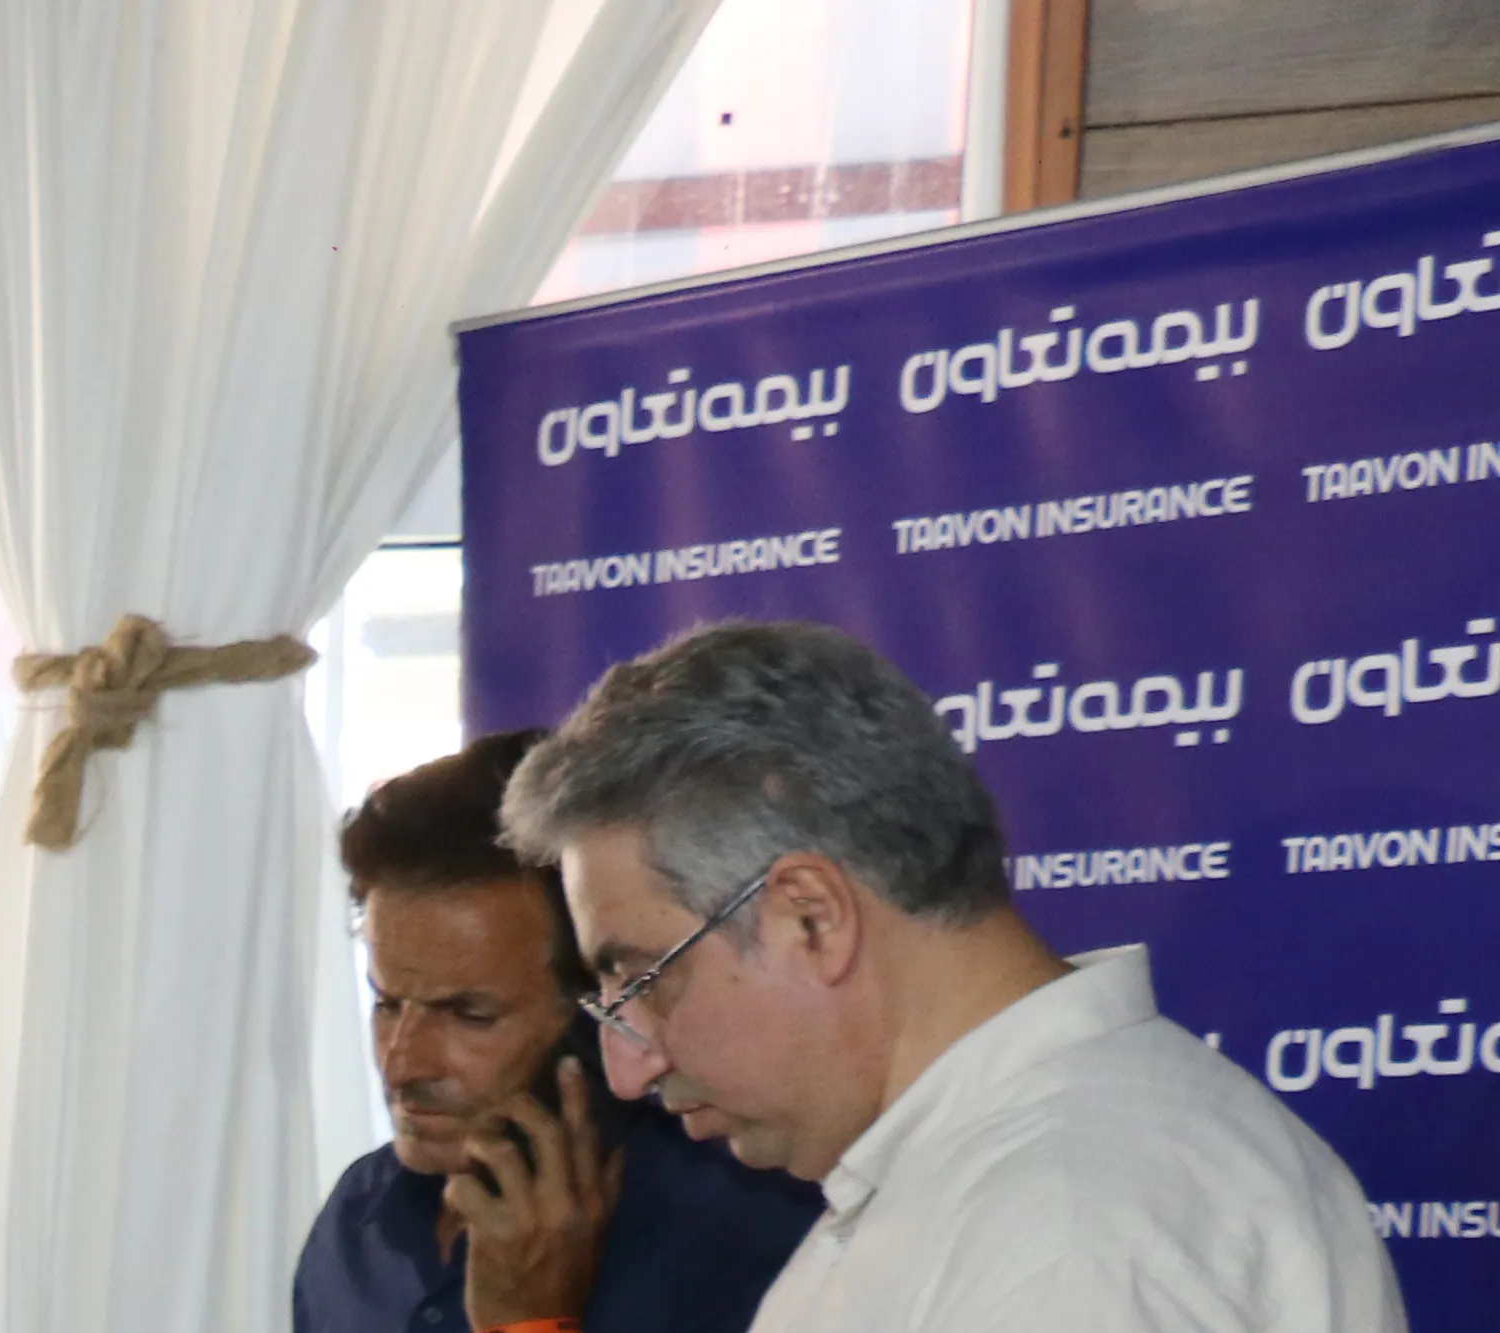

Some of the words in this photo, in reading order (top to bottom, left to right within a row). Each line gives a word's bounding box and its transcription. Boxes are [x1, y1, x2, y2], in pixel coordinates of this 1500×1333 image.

[900, 304, 1083, 414] تعاون
[1085, 298, 1260, 382] بیمه
[537, 366, 697, 466] تعاون
[700, 364, 851, 442] بیمه
[1303, 446, 1461, 503] TAAVON
[892, 505, 1032, 555] TAAVON
[1036, 475, 1255, 538] INSURANCE
[529, 551, 652, 597] TAAVON
[654, 527, 843, 584] INSURANCE
[933, 662, 1067, 754] تعاو
[1068, 667, 1245, 748] بیمه
[1014, 841, 1232, 891] INSURANCE
[1282, 826, 1441, 875] TAAVON
[1265, 997, 1477, 1093] تعاون
